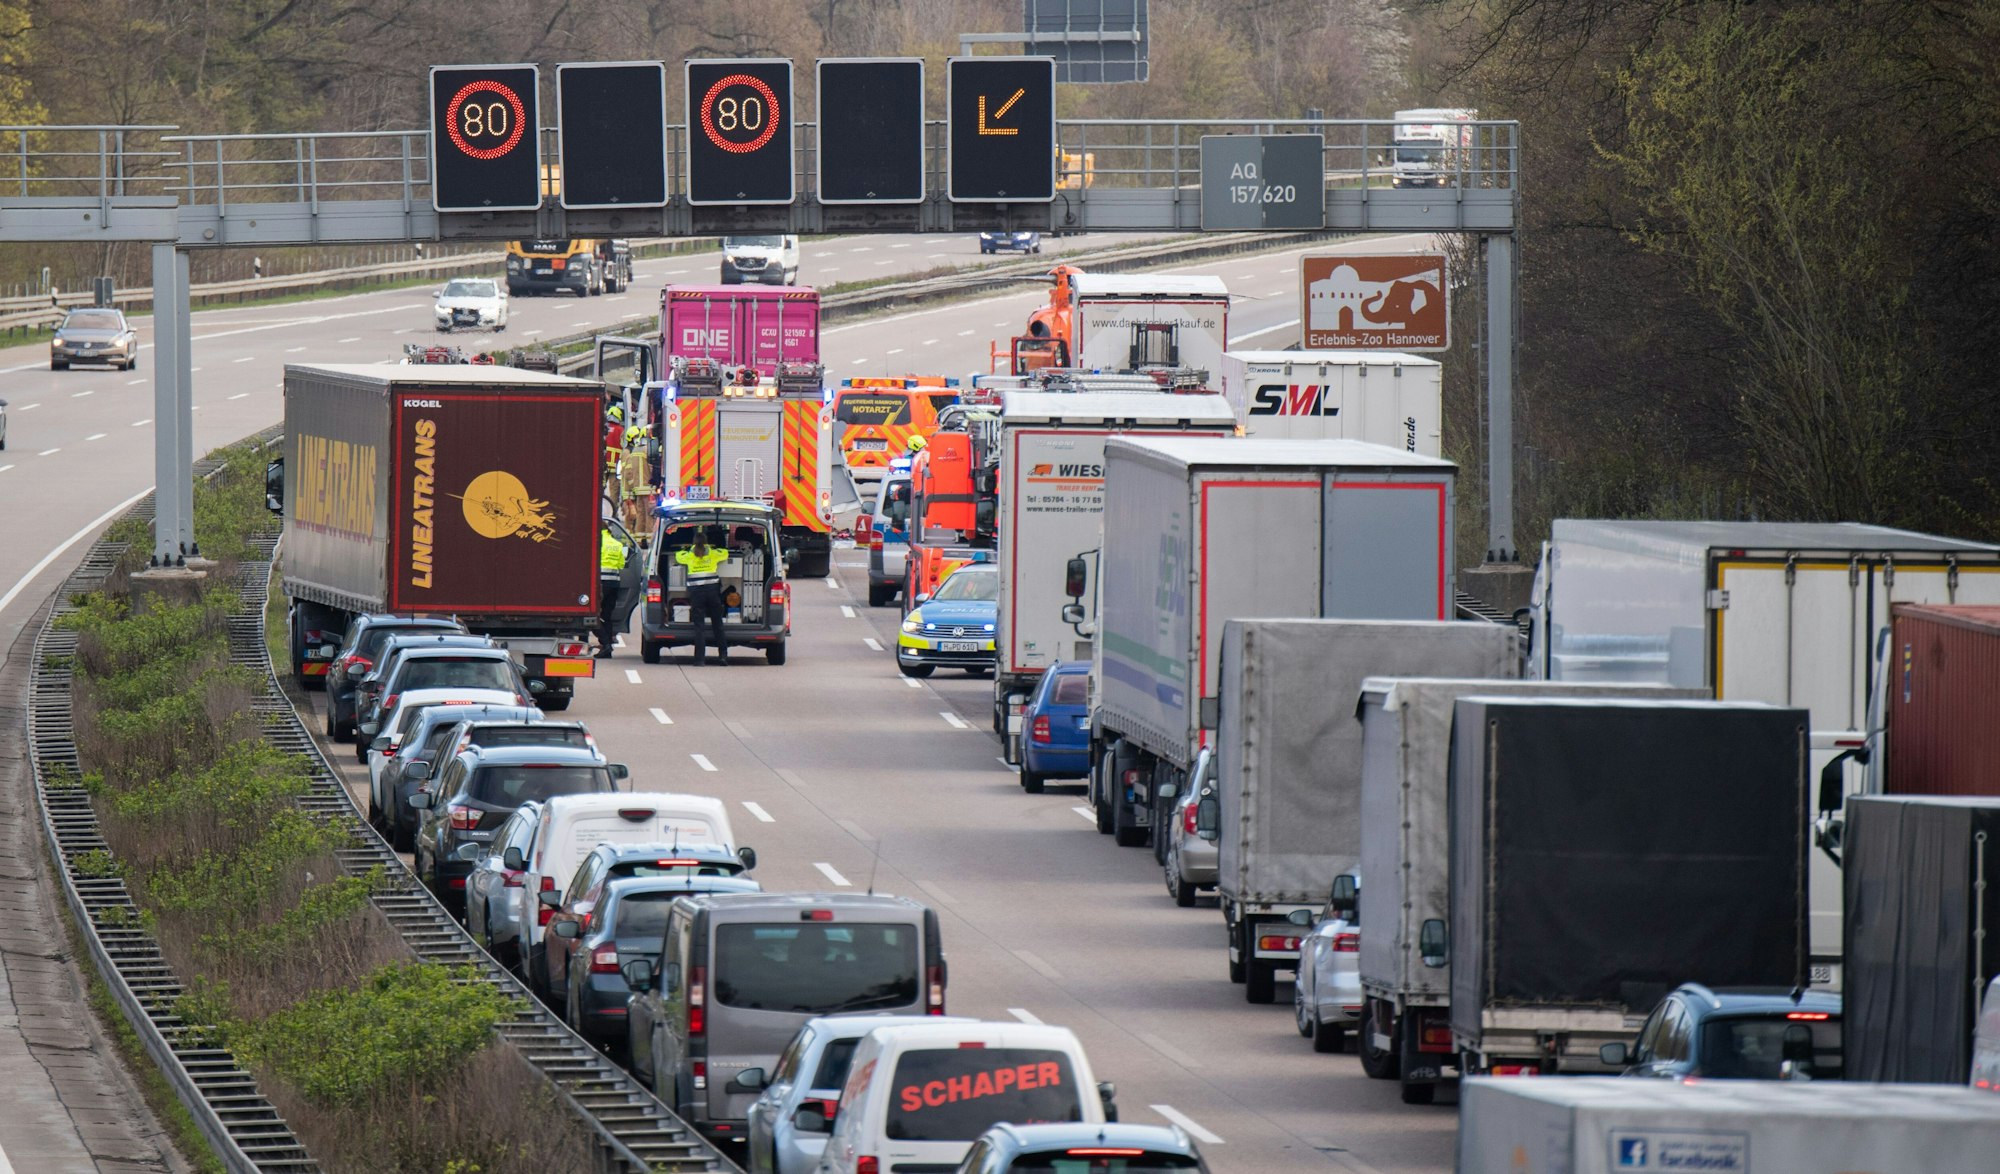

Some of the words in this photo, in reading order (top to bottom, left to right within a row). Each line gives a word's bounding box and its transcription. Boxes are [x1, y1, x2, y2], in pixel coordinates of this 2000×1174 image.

[464, 103, 507, 137] 80
[718, 97, 761, 131] 80
[1230, 162, 1258, 180] AQ
[1230, 185, 1296, 204] 157,620
[682, 328, 729, 347] ONE
[1309, 334, 1383, 346] Erlebnis-Zoo
[1386, 334, 1440, 345] Hannover
[404, 399, 442, 408] KÖGEL
[852, 406, 892, 414] NOTARZT
[1249, 384, 1340, 417] SML
[1059, 464, 1105, 478] WIES
[295, 433, 377, 542] LINEATRANS
[411, 418, 437, 589] LINEATRANS
[961, 643, 975, 651] 610
[901, 1061, 1061, 1112] SCHAPER
